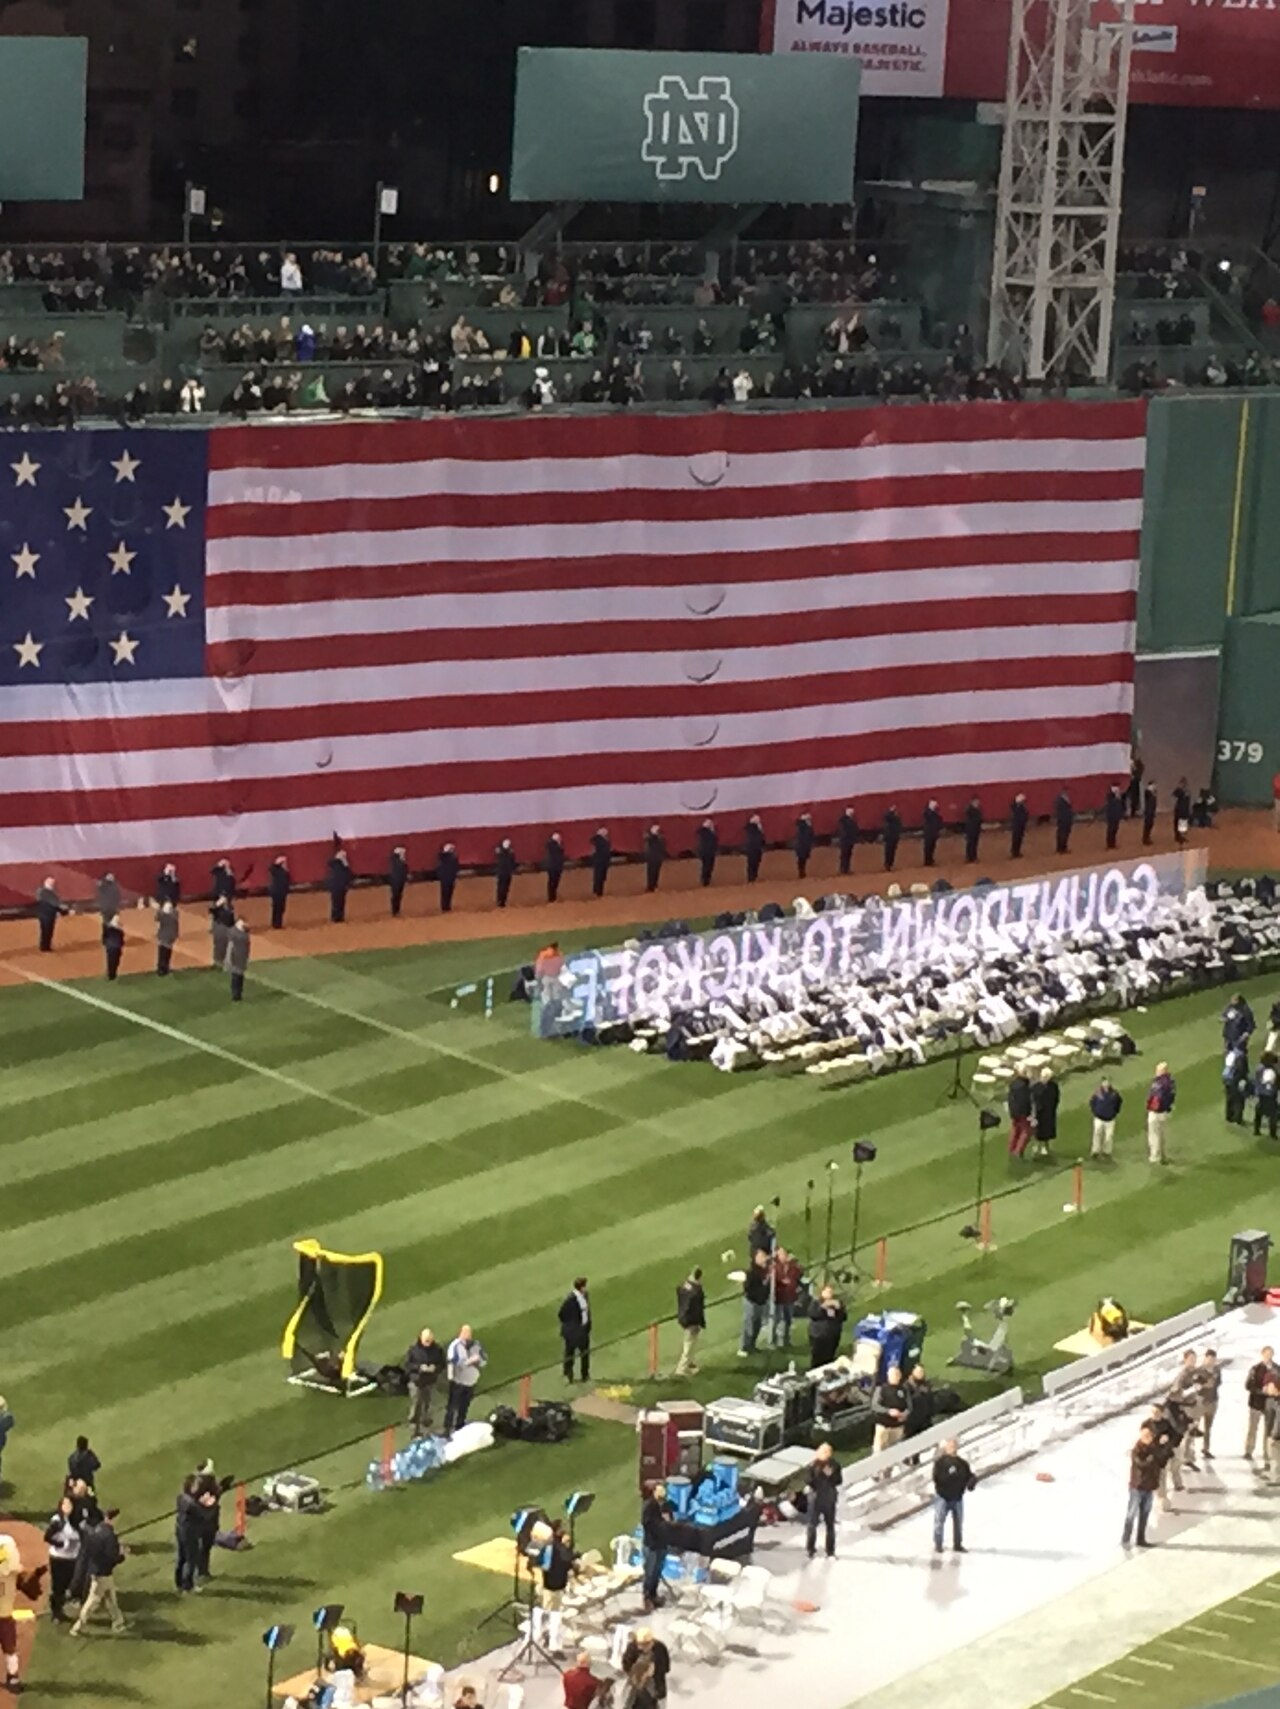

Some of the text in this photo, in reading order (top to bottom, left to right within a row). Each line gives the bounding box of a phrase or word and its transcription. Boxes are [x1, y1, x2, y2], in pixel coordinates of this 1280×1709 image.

[796, 0, 926, 35] Majestic
[790, 40, 849, 53] ALWAYS
[1217, 739, 1264, 764] 379
